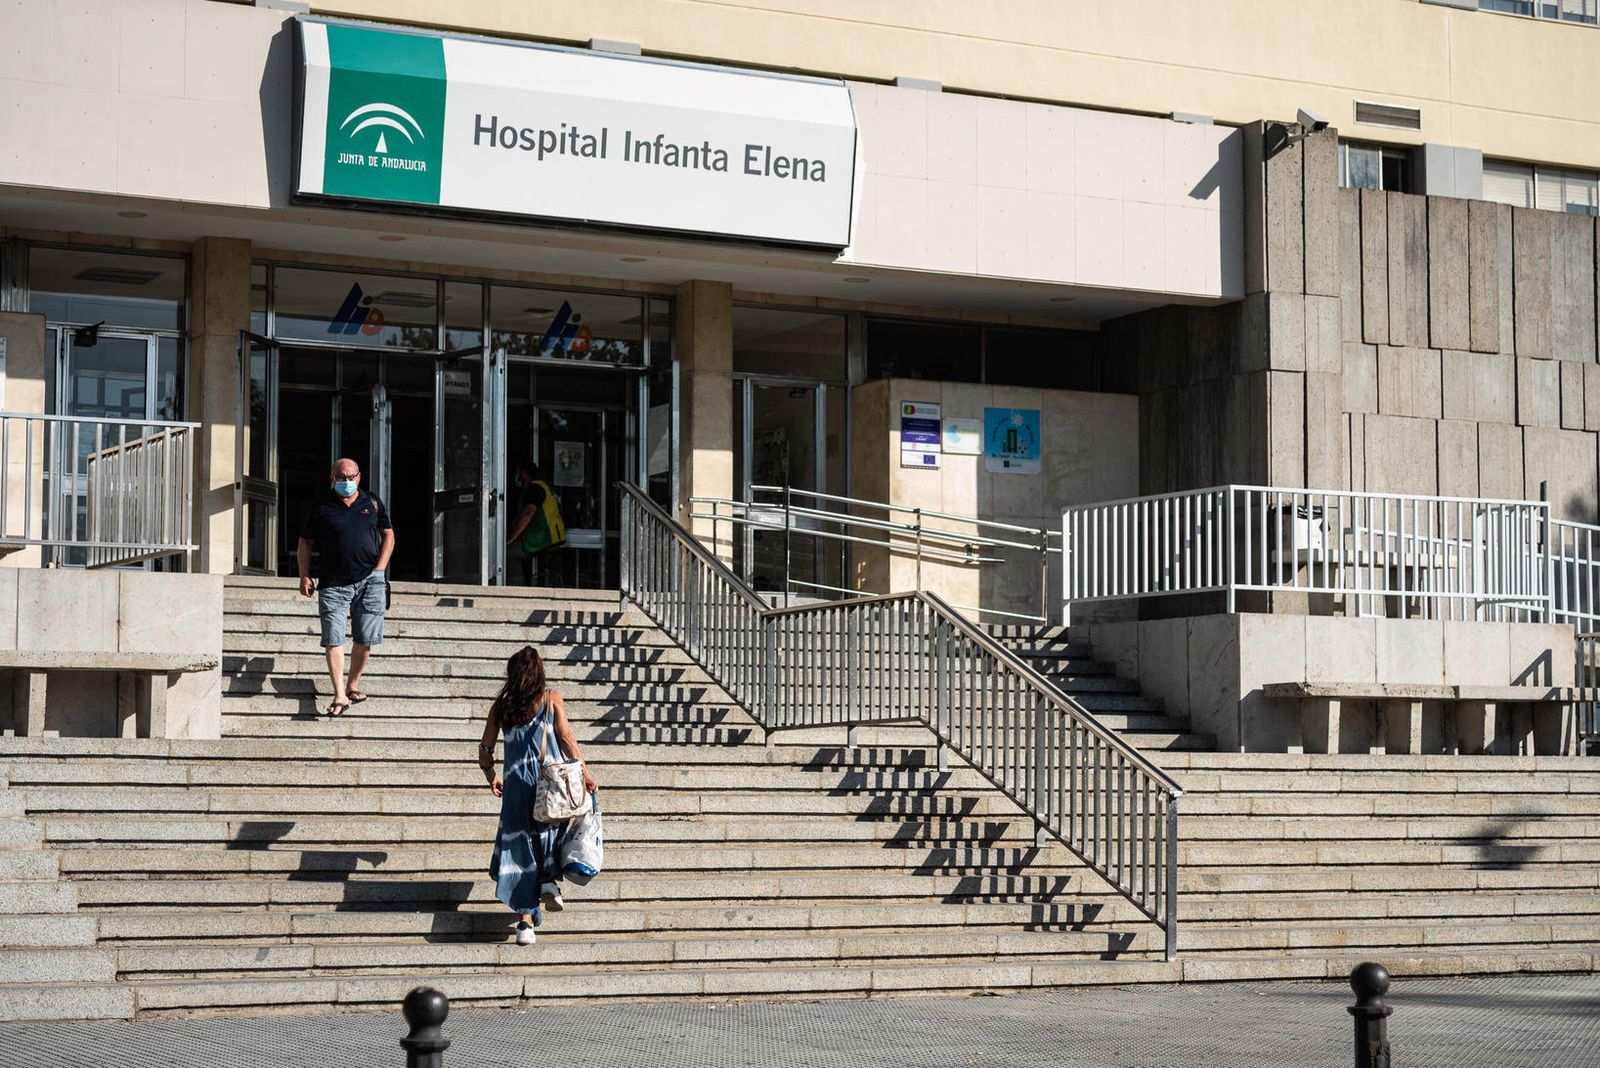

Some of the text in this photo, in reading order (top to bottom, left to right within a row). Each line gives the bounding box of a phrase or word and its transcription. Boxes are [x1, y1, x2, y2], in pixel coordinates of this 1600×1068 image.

[337, 152, 427, 172] JUNTA DE ANDALUCIA
[473, 113, 826, 183] Hospital Infanta Elena
